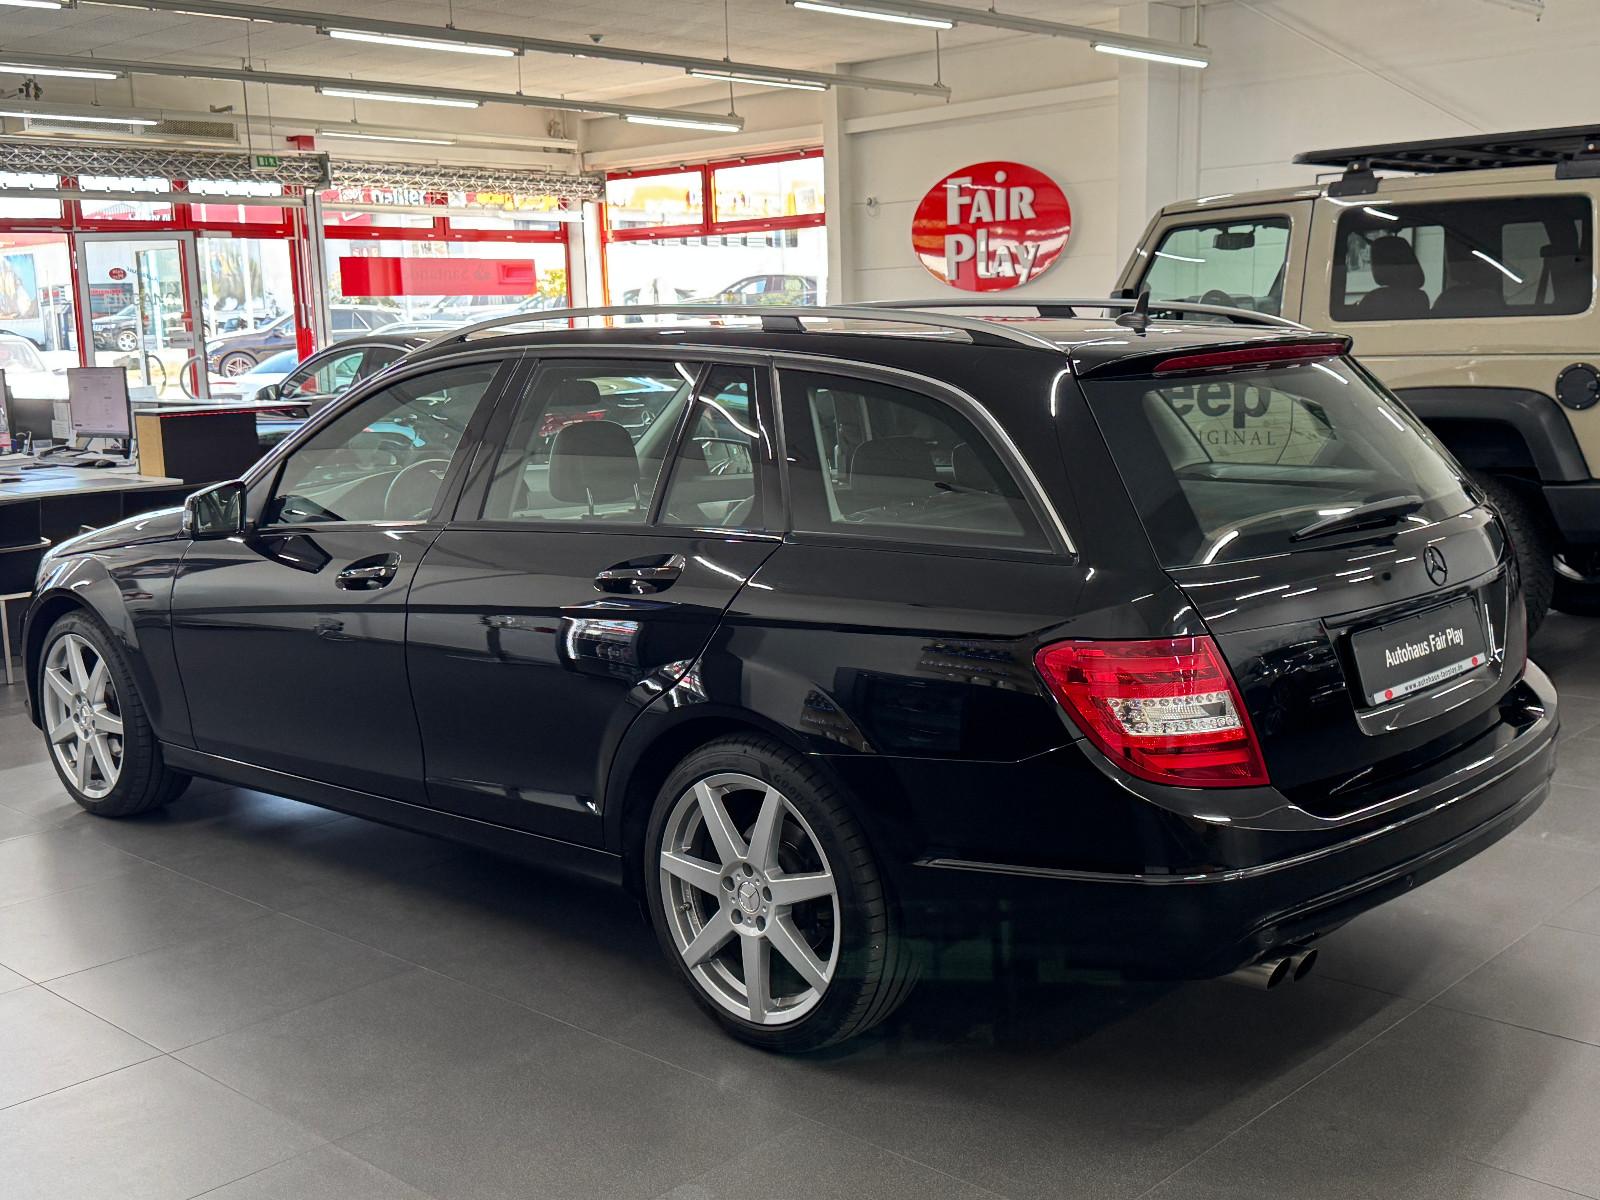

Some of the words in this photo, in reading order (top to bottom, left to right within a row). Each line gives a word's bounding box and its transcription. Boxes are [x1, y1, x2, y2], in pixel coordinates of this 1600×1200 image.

[1166, 383, 1271, 429] eep
[1199, 430, 1277, 447] IGINAL
[1385, 641, 1429, 668] Autohaus
[1428, 632, 1447, 652] Fair
[1446, 628, 1464, 646] Play
